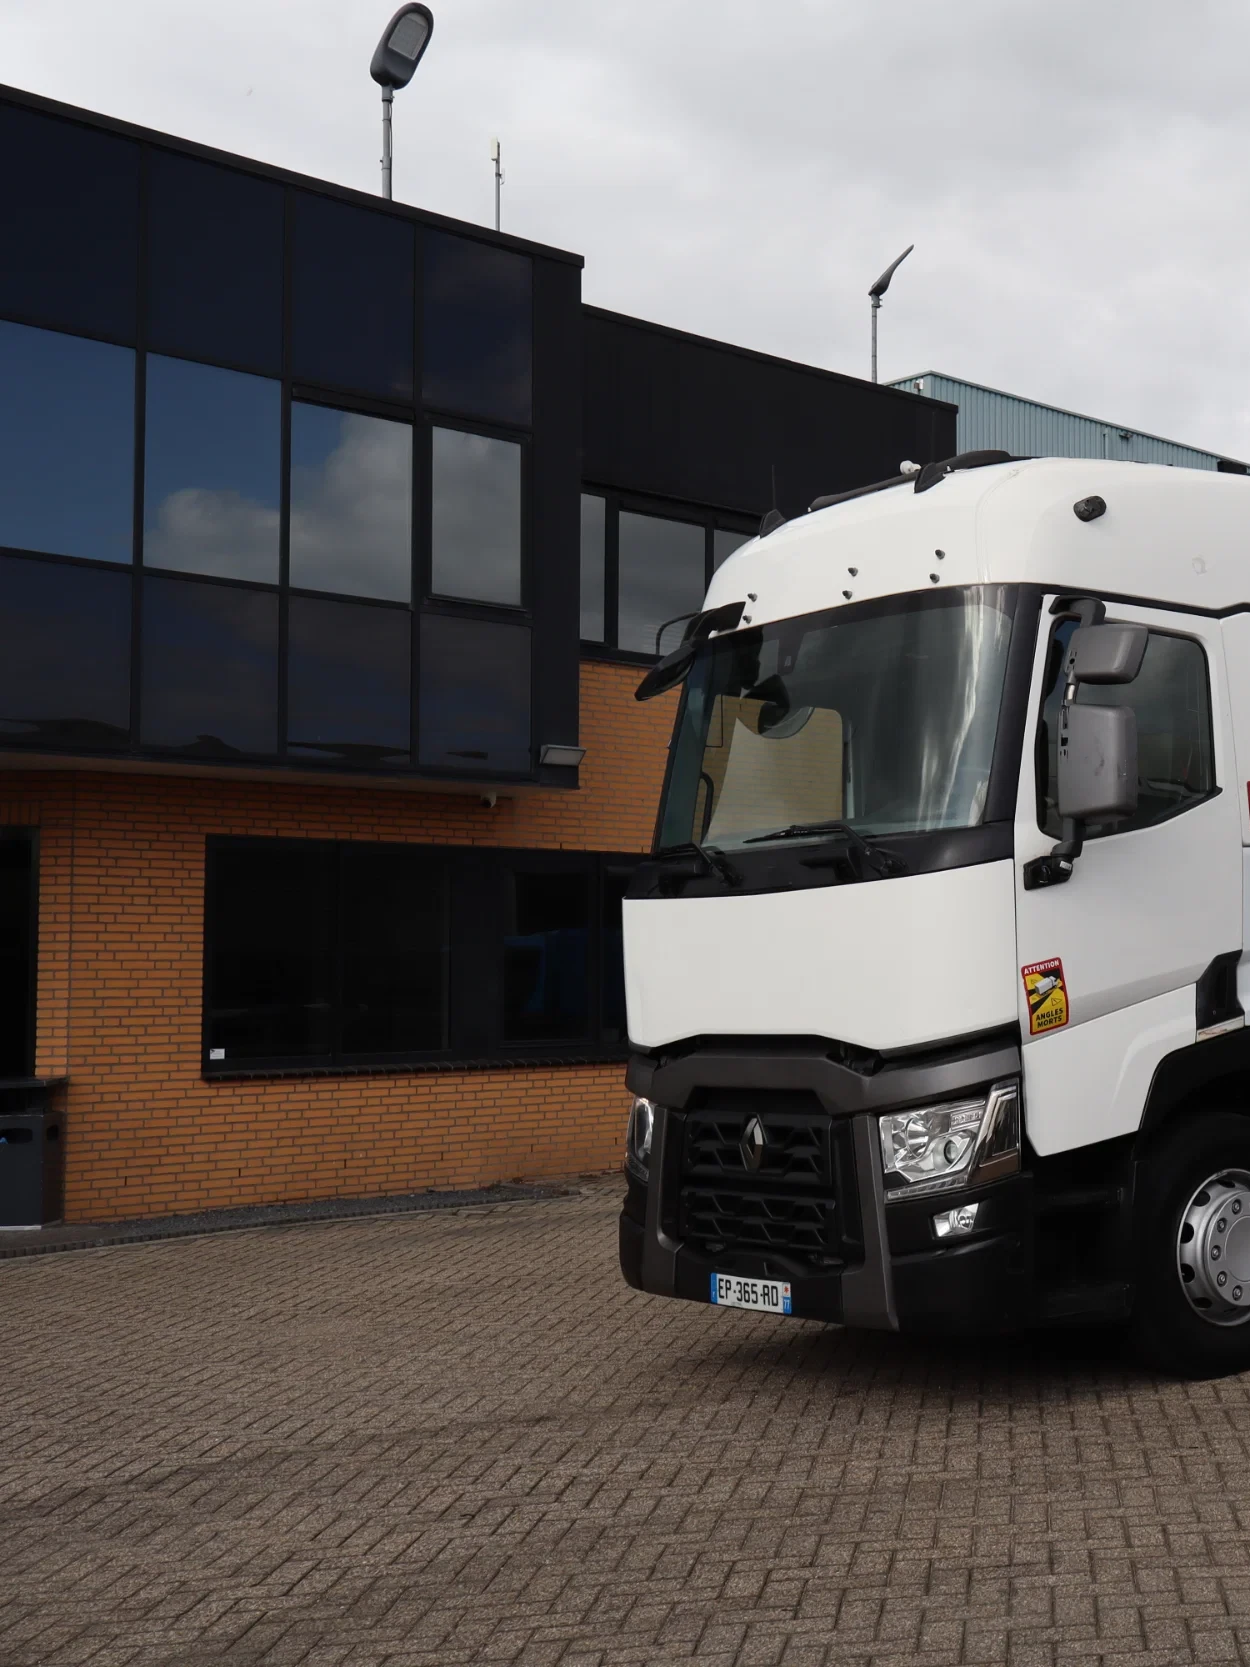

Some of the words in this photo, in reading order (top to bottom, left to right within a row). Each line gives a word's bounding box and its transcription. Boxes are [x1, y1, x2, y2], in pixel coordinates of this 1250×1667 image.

[1024, 959, 1060, 975] ATTENTION
[1035, 1007, 1064, 1022] ANGLES
[1037, 1015, 1063, 1029] MORTS
